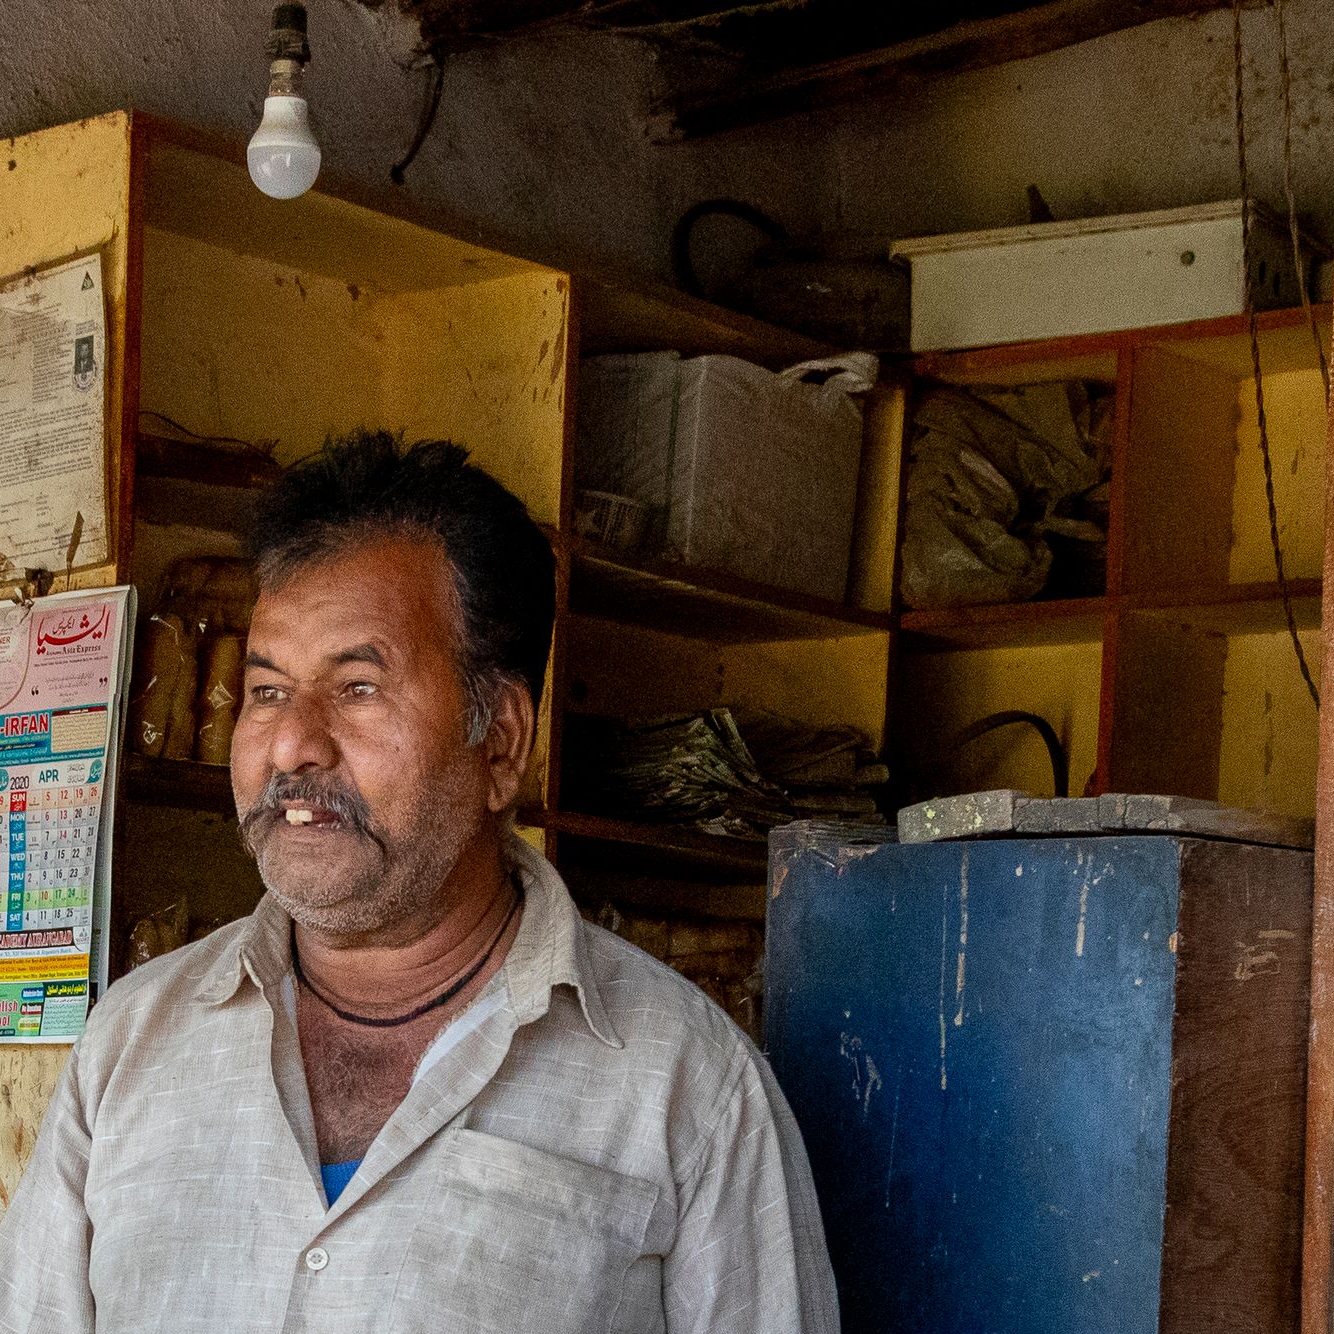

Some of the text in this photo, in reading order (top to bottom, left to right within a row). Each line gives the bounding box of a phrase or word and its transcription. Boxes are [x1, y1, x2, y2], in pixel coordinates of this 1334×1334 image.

[76, 644, 101, 654] Express
[38, 770, 59, 783] APR
[10, 776, 29, 791] 2020
[11, 793, 25, 801] SUN
[47, 792, 51, 800] 5
[60, 790, 68, 799] 12
[75, 789, 83, 798] 19
[90, 787, 98, 796] 26
[45, 812, 49, 820] 6
[60, 810, 67, 819] 13
[75, 809, 82, 818] 20
[89, 807, 96, 816] 27
[45, 832, 49, 840] 7
[60, 830, 67, 839] 14
[74, 829, 81, 838] 21
[29, 854, 32, 862] 1
[58, 850, 65, 858] 15
[72, 849, 80, 857] 22
[28, 874, 32, 882] 2
[43, 871, 47, 879] 9
[56, 870, 62, 878] 16
[70, 869, 78, 877] 23
[55, 890, 62, 898] 17
[68, 889, 76, 897] 24
[26, 911, 29, 920] 4
[40, 910, 47, 919] 11
[66, 908, 73, 916] 25
